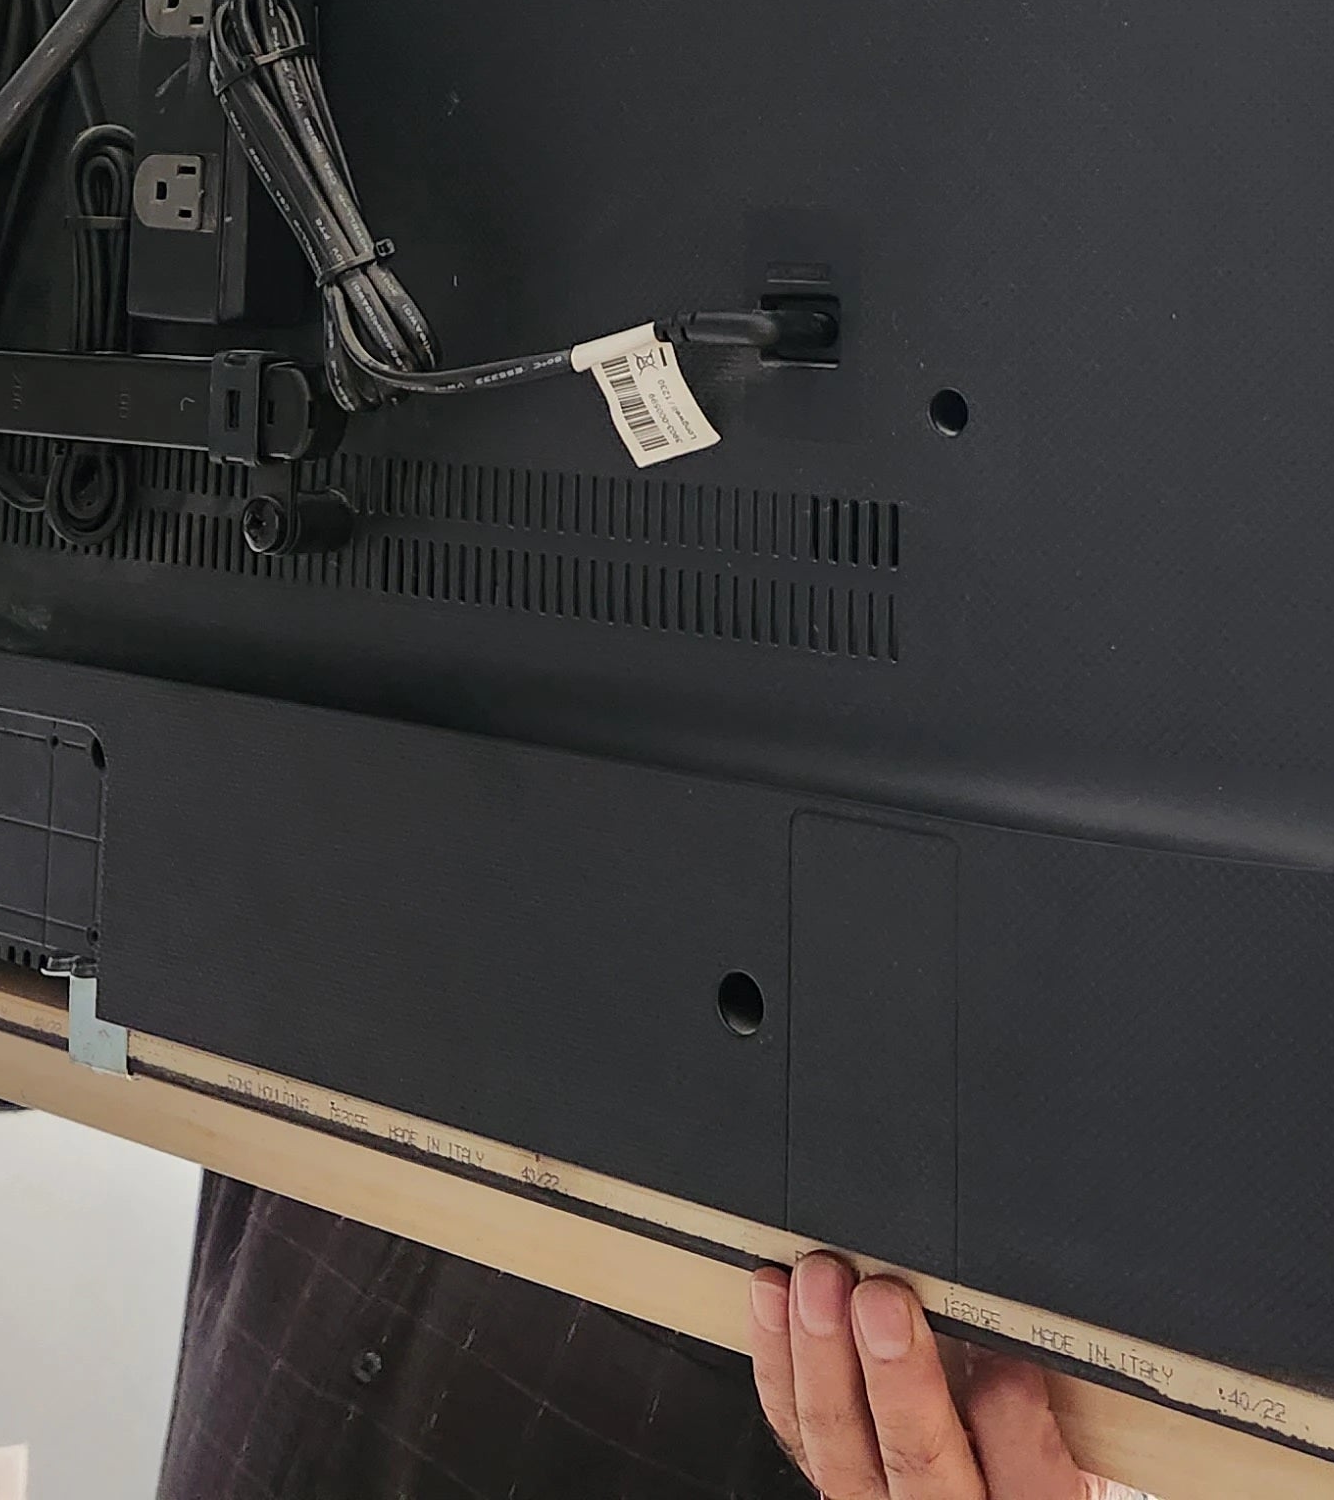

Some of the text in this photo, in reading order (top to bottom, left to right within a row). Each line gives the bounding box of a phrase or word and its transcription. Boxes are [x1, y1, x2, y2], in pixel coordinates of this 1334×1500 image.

[657, 379, 671, 400] 1230
[427, 1135, 441, 1152] IN
[449, 1142, 485, 1165] ITALY
[944, 1297, 1287, 1424] 162055 MADE IN ITALY 40/22
